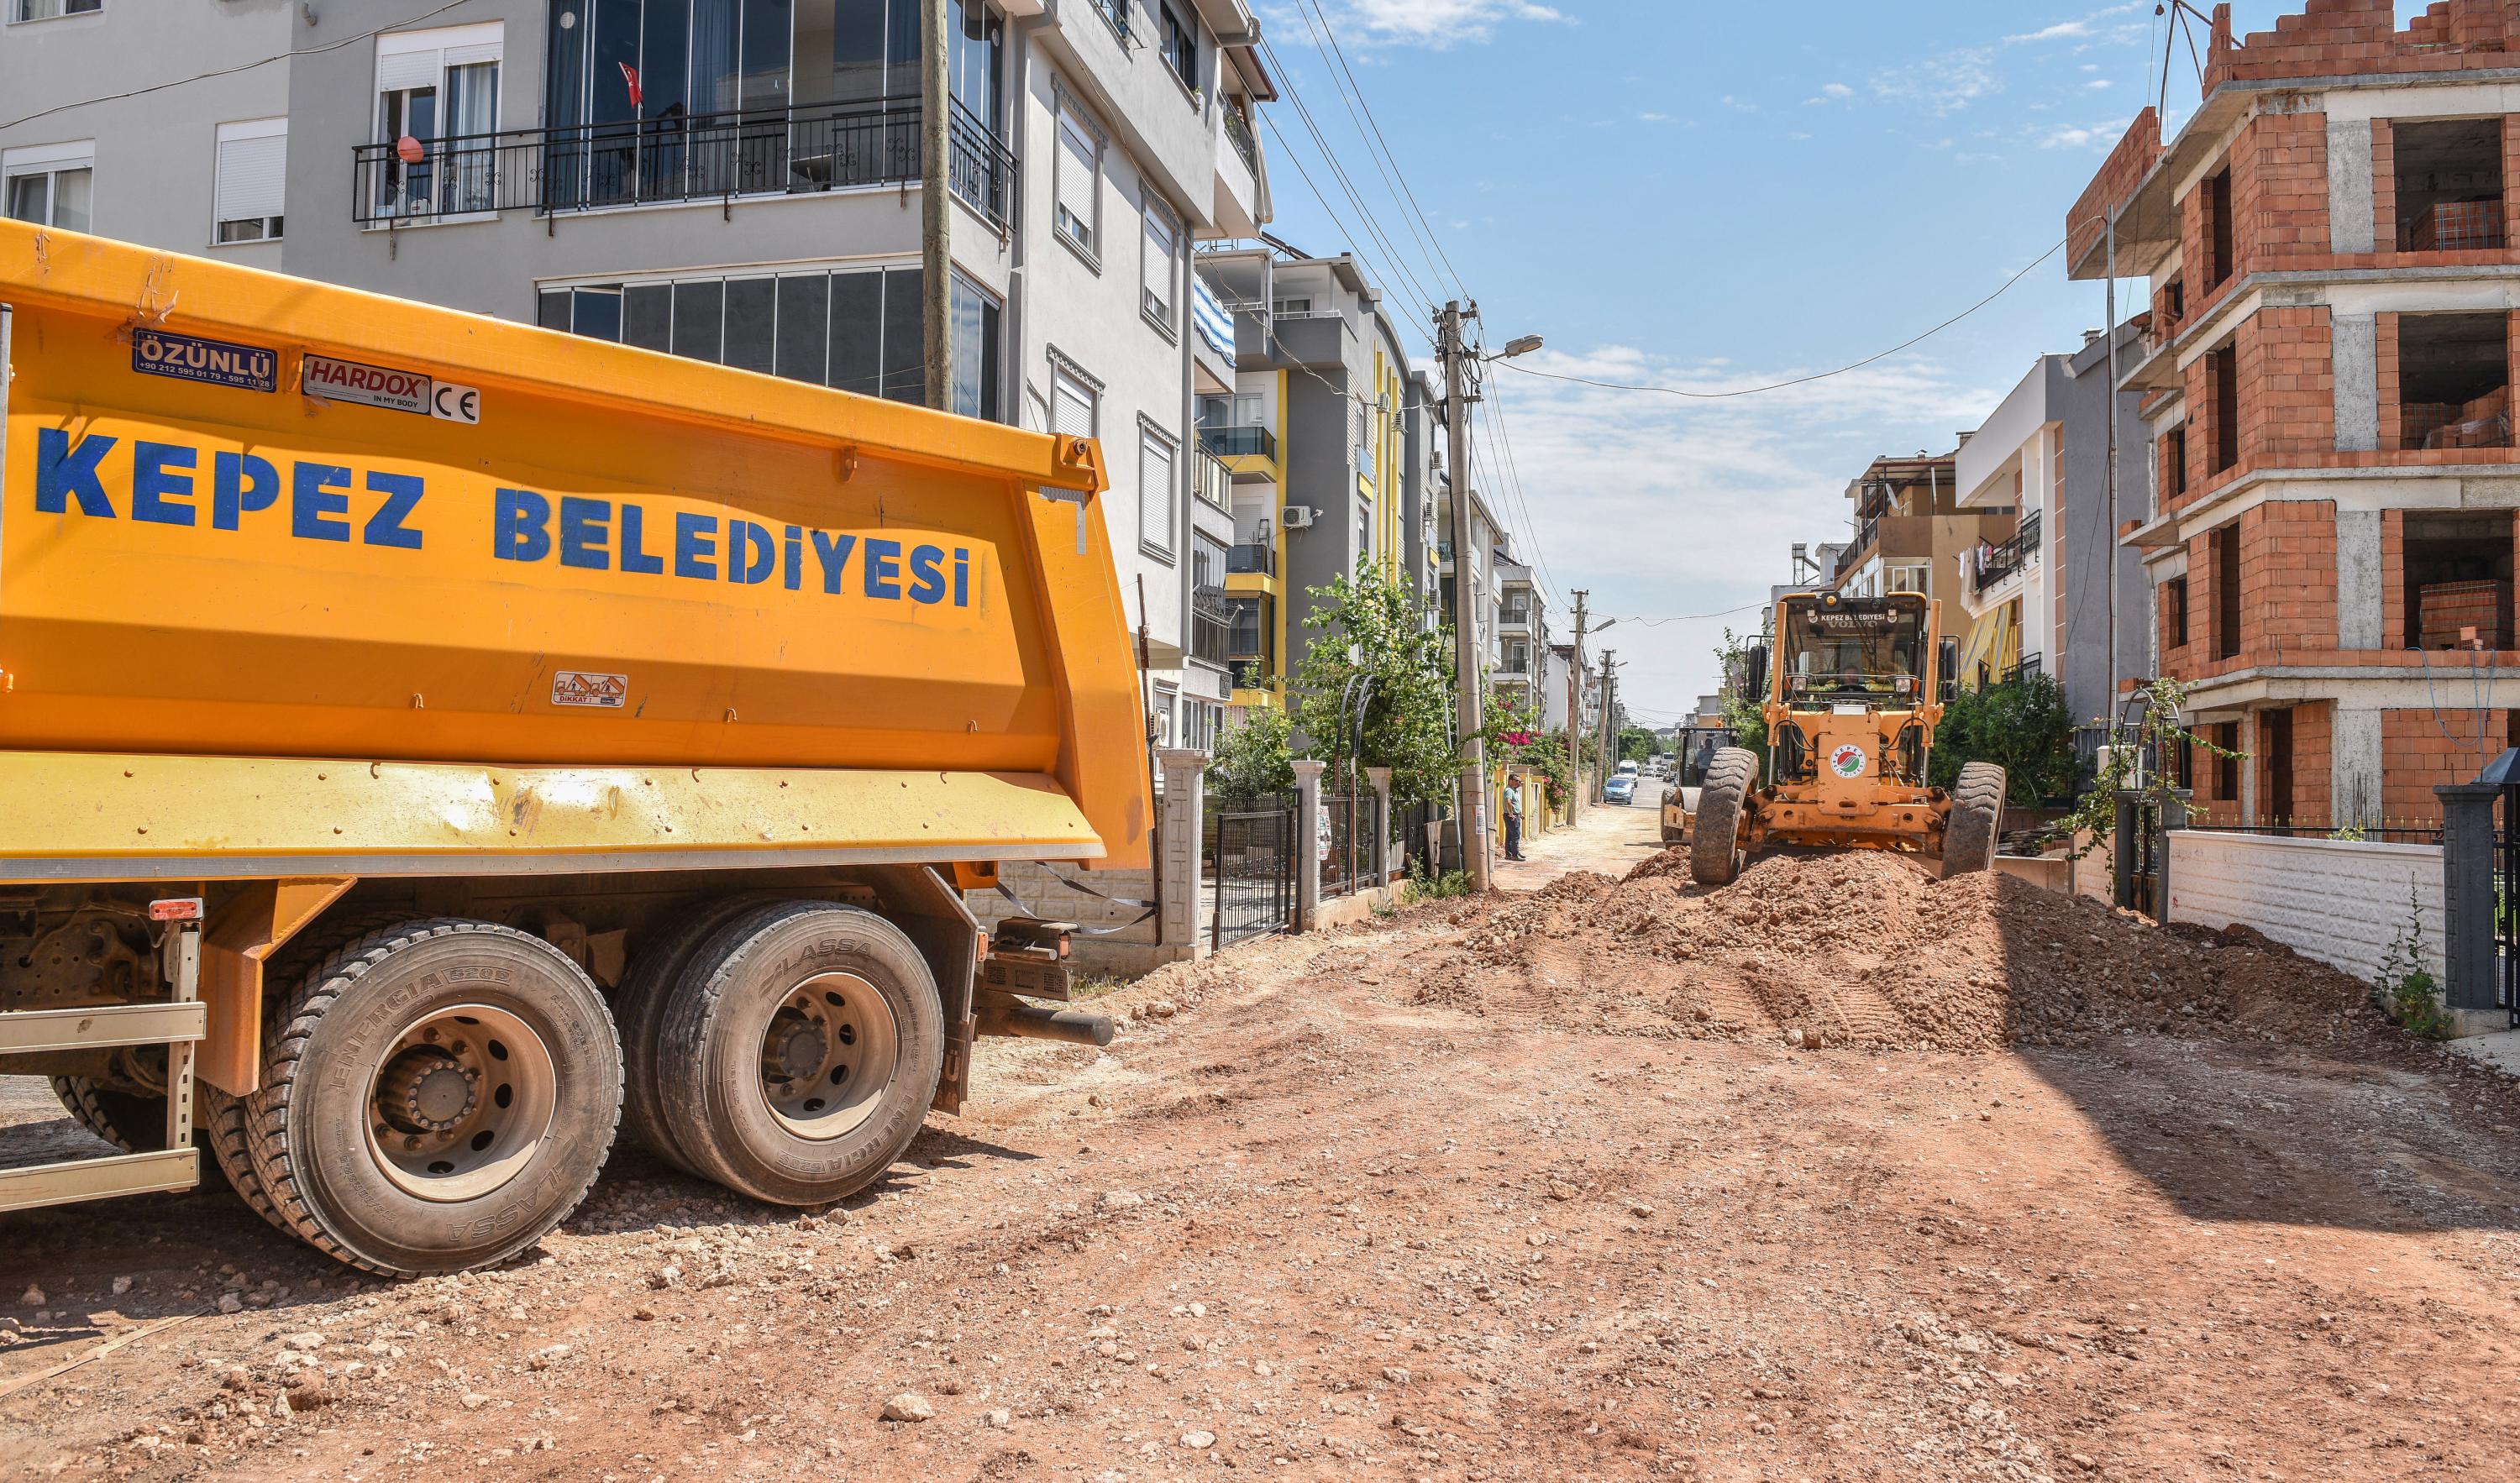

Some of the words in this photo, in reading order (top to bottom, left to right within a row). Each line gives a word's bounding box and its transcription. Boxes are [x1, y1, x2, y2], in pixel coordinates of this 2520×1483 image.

[141, 335, 270, 378] ÖZÜNLÜ
[159, 364, 176, 373] 212
[228, 375, 244, 384] 595
[397, 399, 418, 408] BODY
[35, 427, 423, 550] KEPEZ
[493, 487, 969, 607] BELEDİYESİ
[329, 972, 444, 1088] ENERGIA
[827, 1093, 914, 1172] ENERGIA
